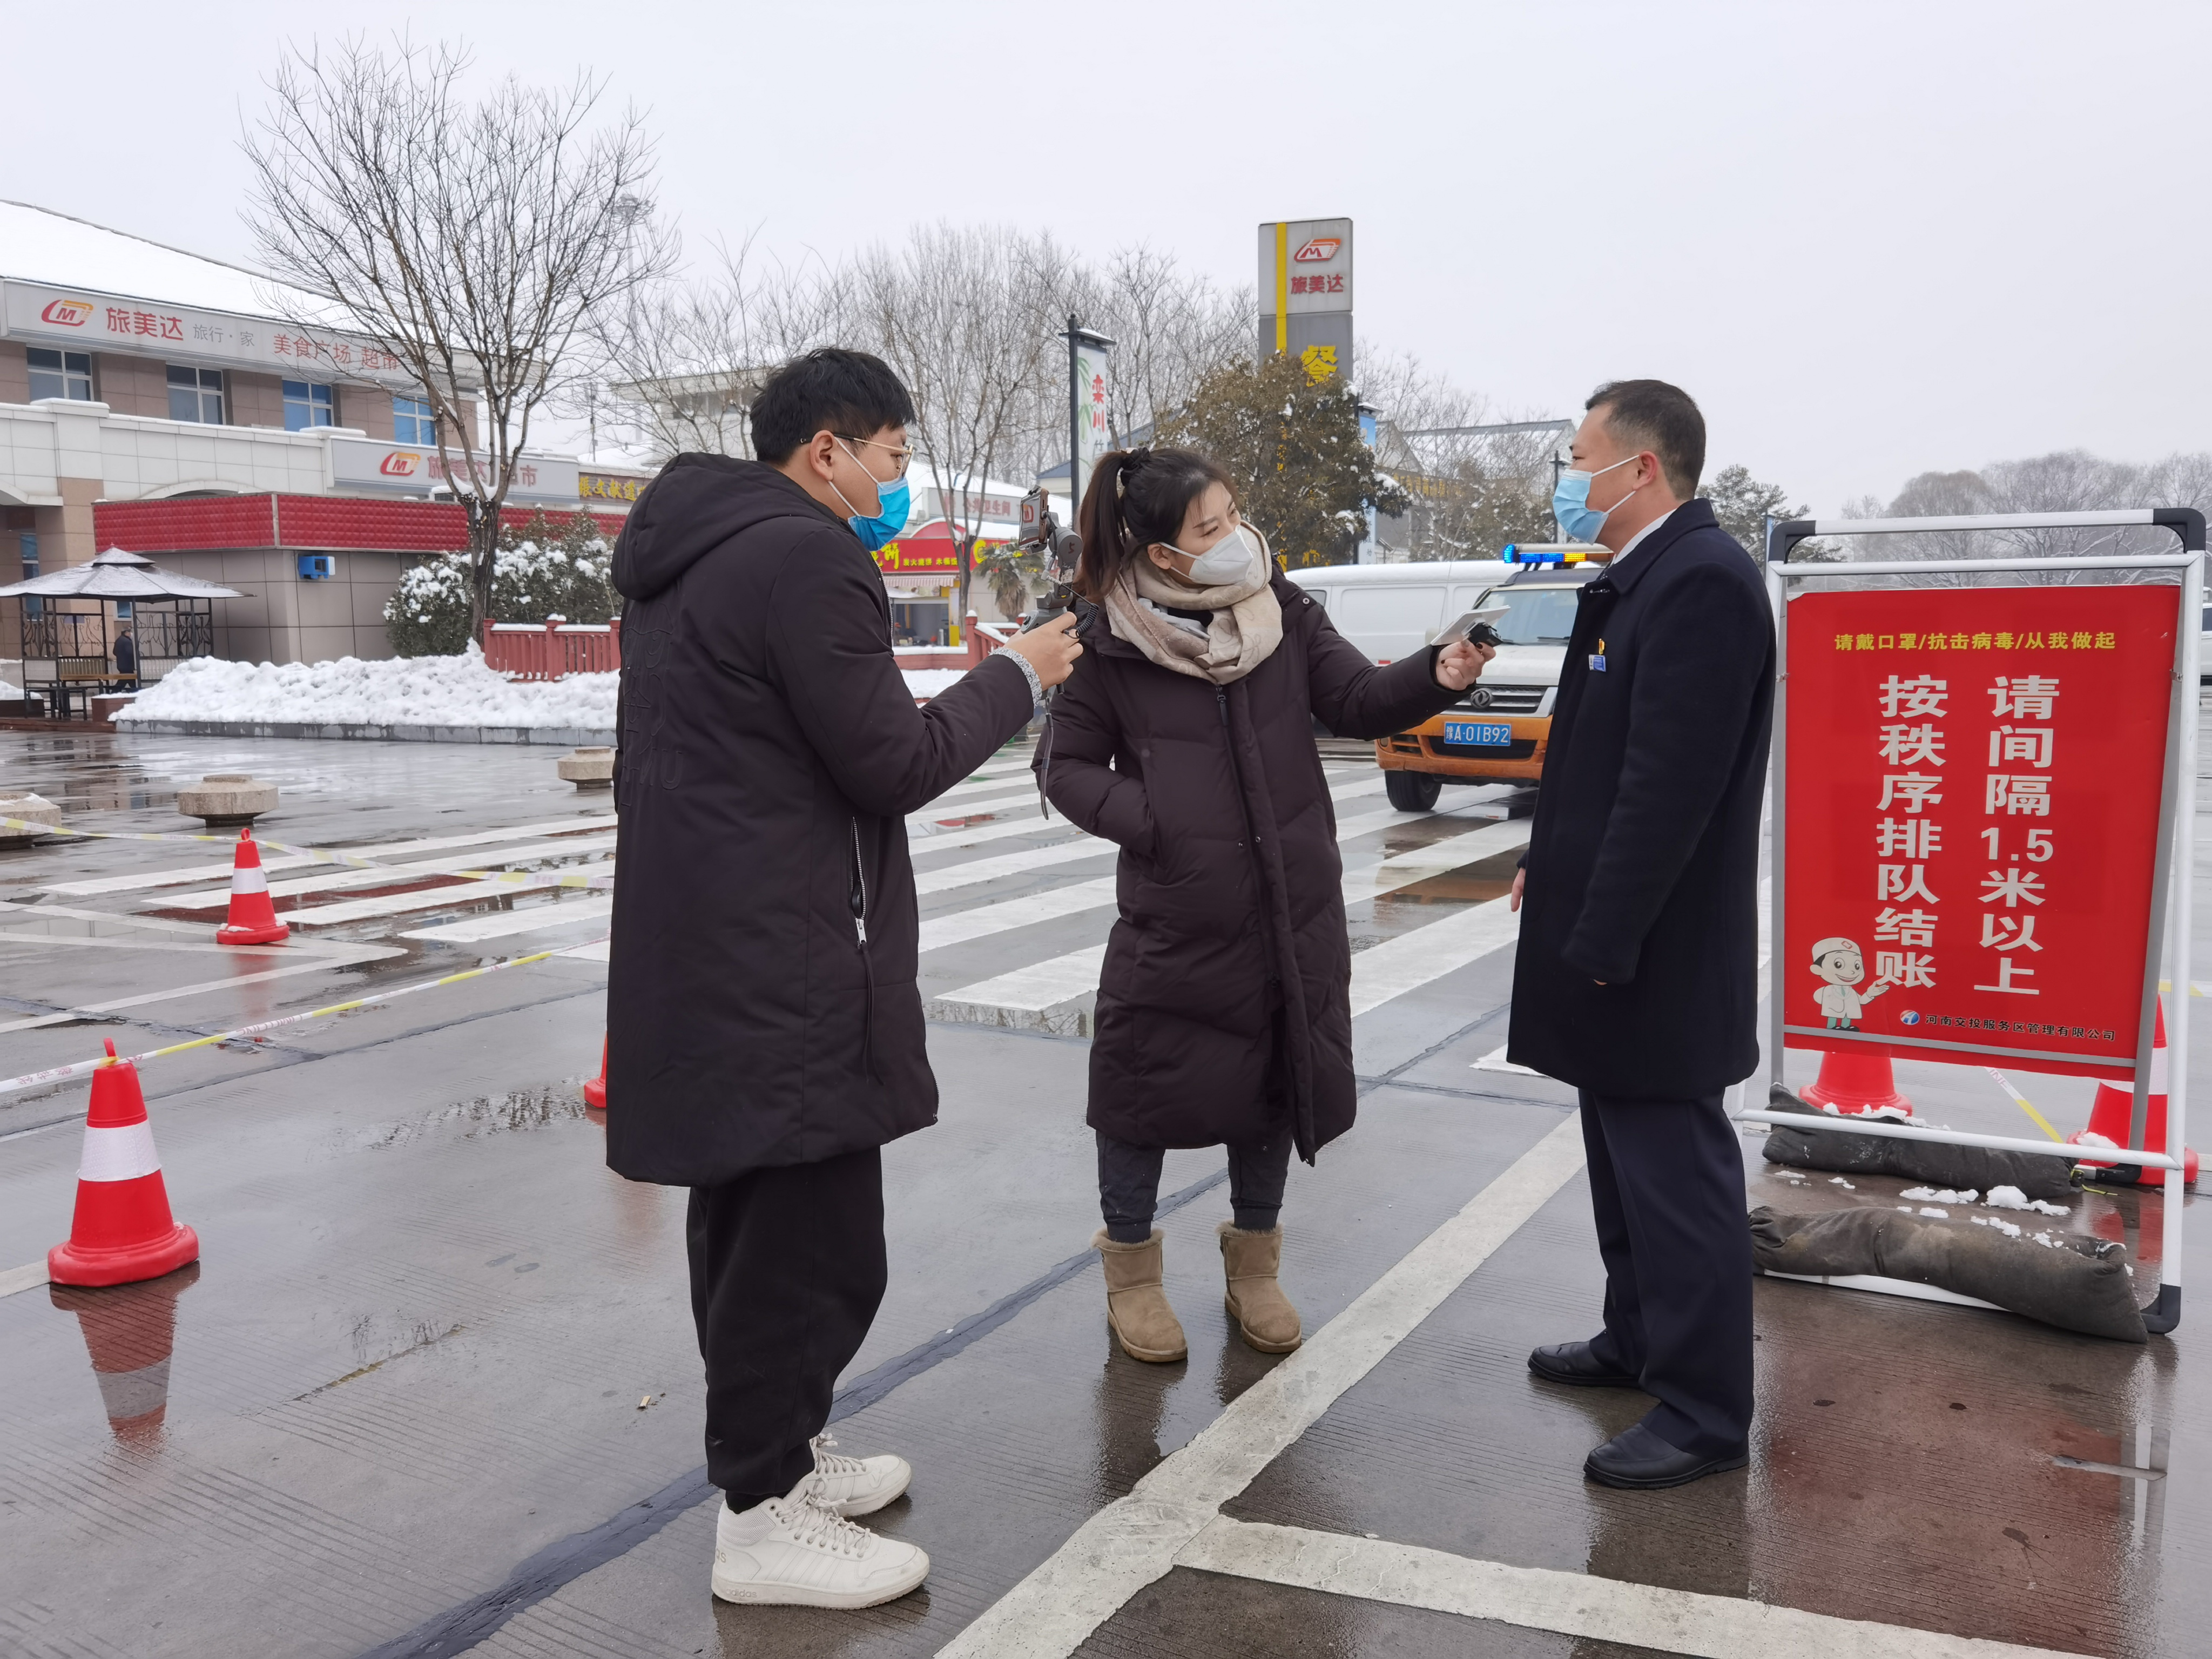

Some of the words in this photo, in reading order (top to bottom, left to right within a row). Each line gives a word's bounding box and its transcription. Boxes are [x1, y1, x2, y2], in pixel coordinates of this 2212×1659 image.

[1291, 274, 1344, 294] 旅美达
[106, 307, 184, 341] 旅美达
[273, 334, 351, 364] 美食广场
[1834, 631, 2116, 651] 请戴口罩/抗击病毒/从我做起
[1873, 674, 1949, 989] 按秩序排队结账
[1925, 1014, 2116, 1041] 河南交投服务区管理有限公司
